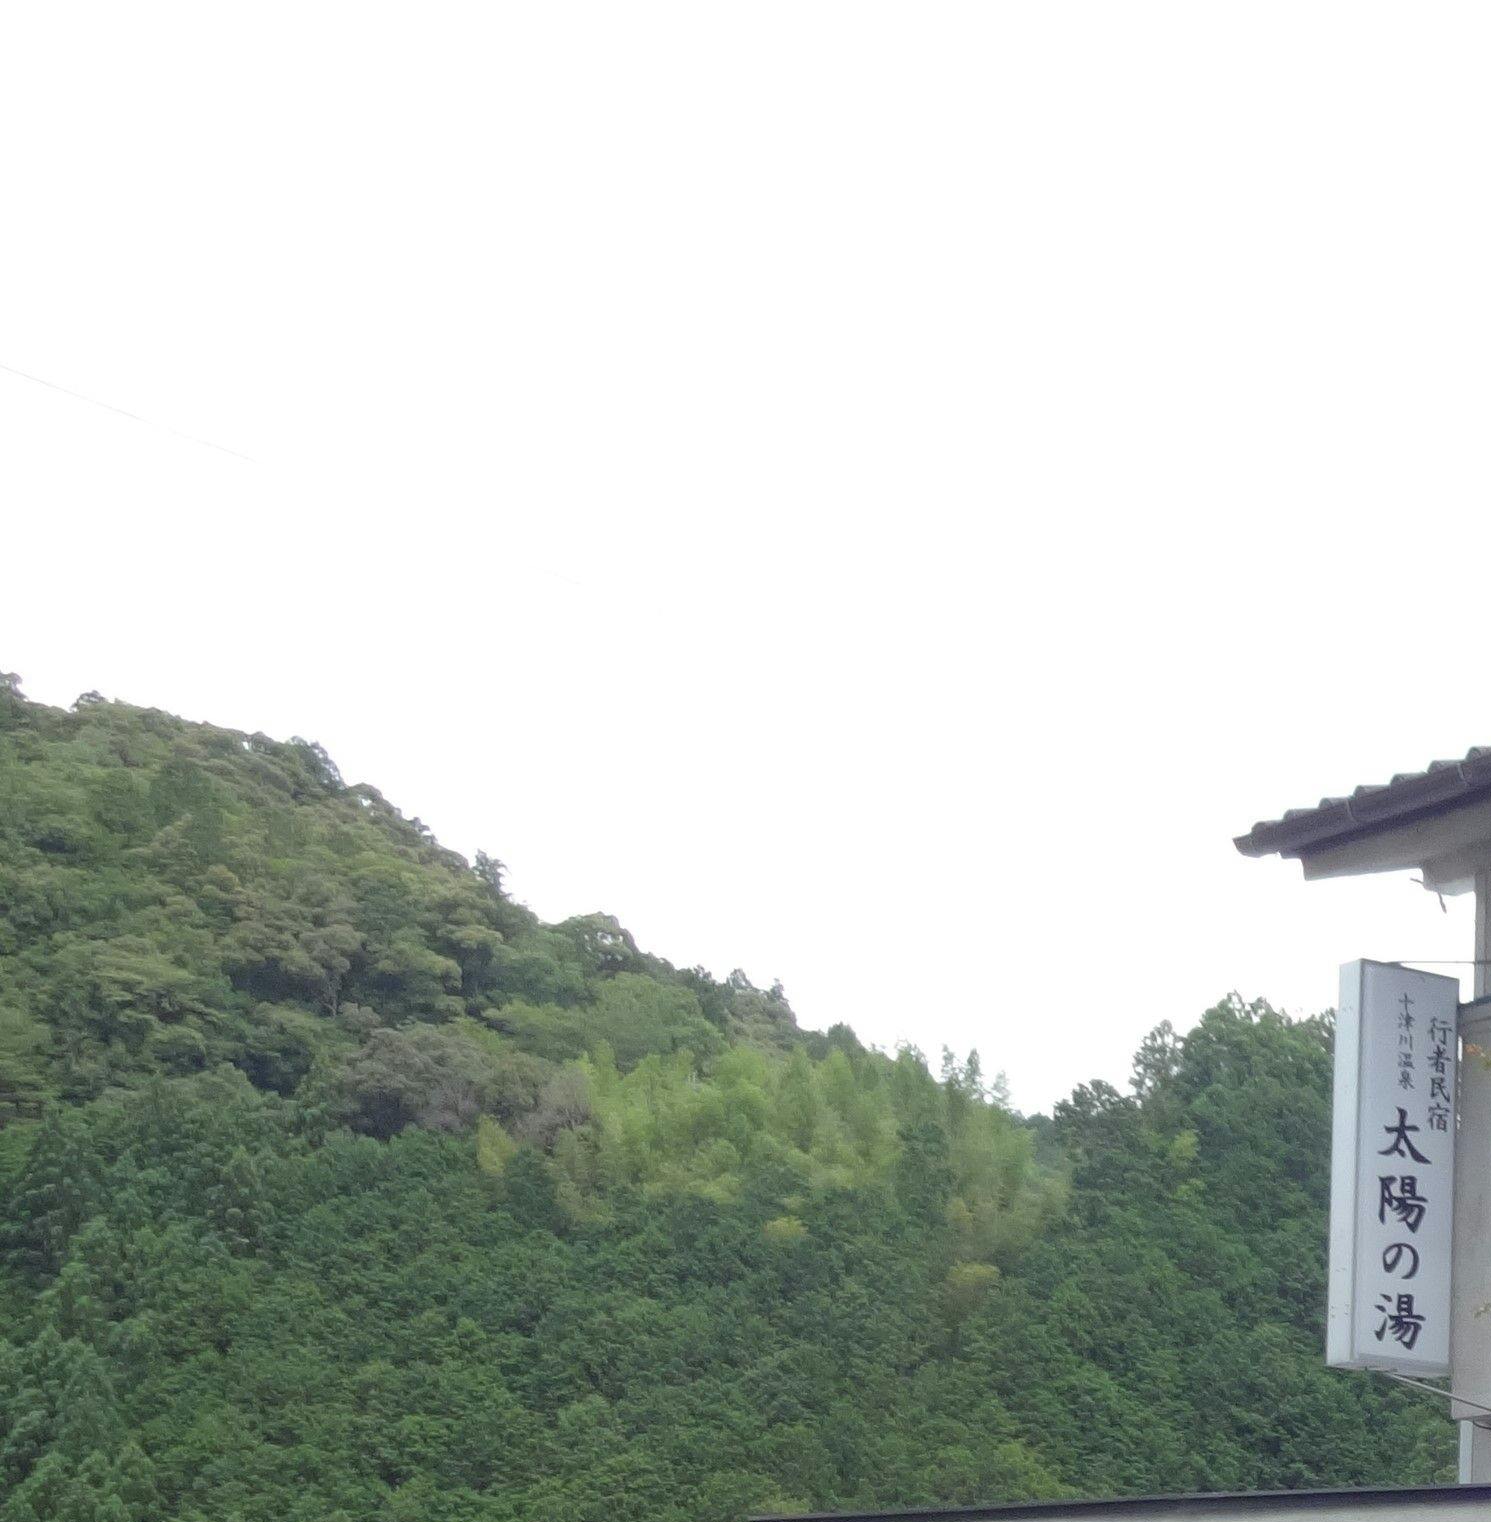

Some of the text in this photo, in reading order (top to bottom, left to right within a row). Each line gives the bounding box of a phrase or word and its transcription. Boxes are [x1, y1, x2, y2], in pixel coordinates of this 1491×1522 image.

[1398, 992, 1416, 1091] 十津川温泉
[1427, 1017, 1451, 1133] 行者民宿
[1374, 1106, 1432, 1350] 太陽の湯
